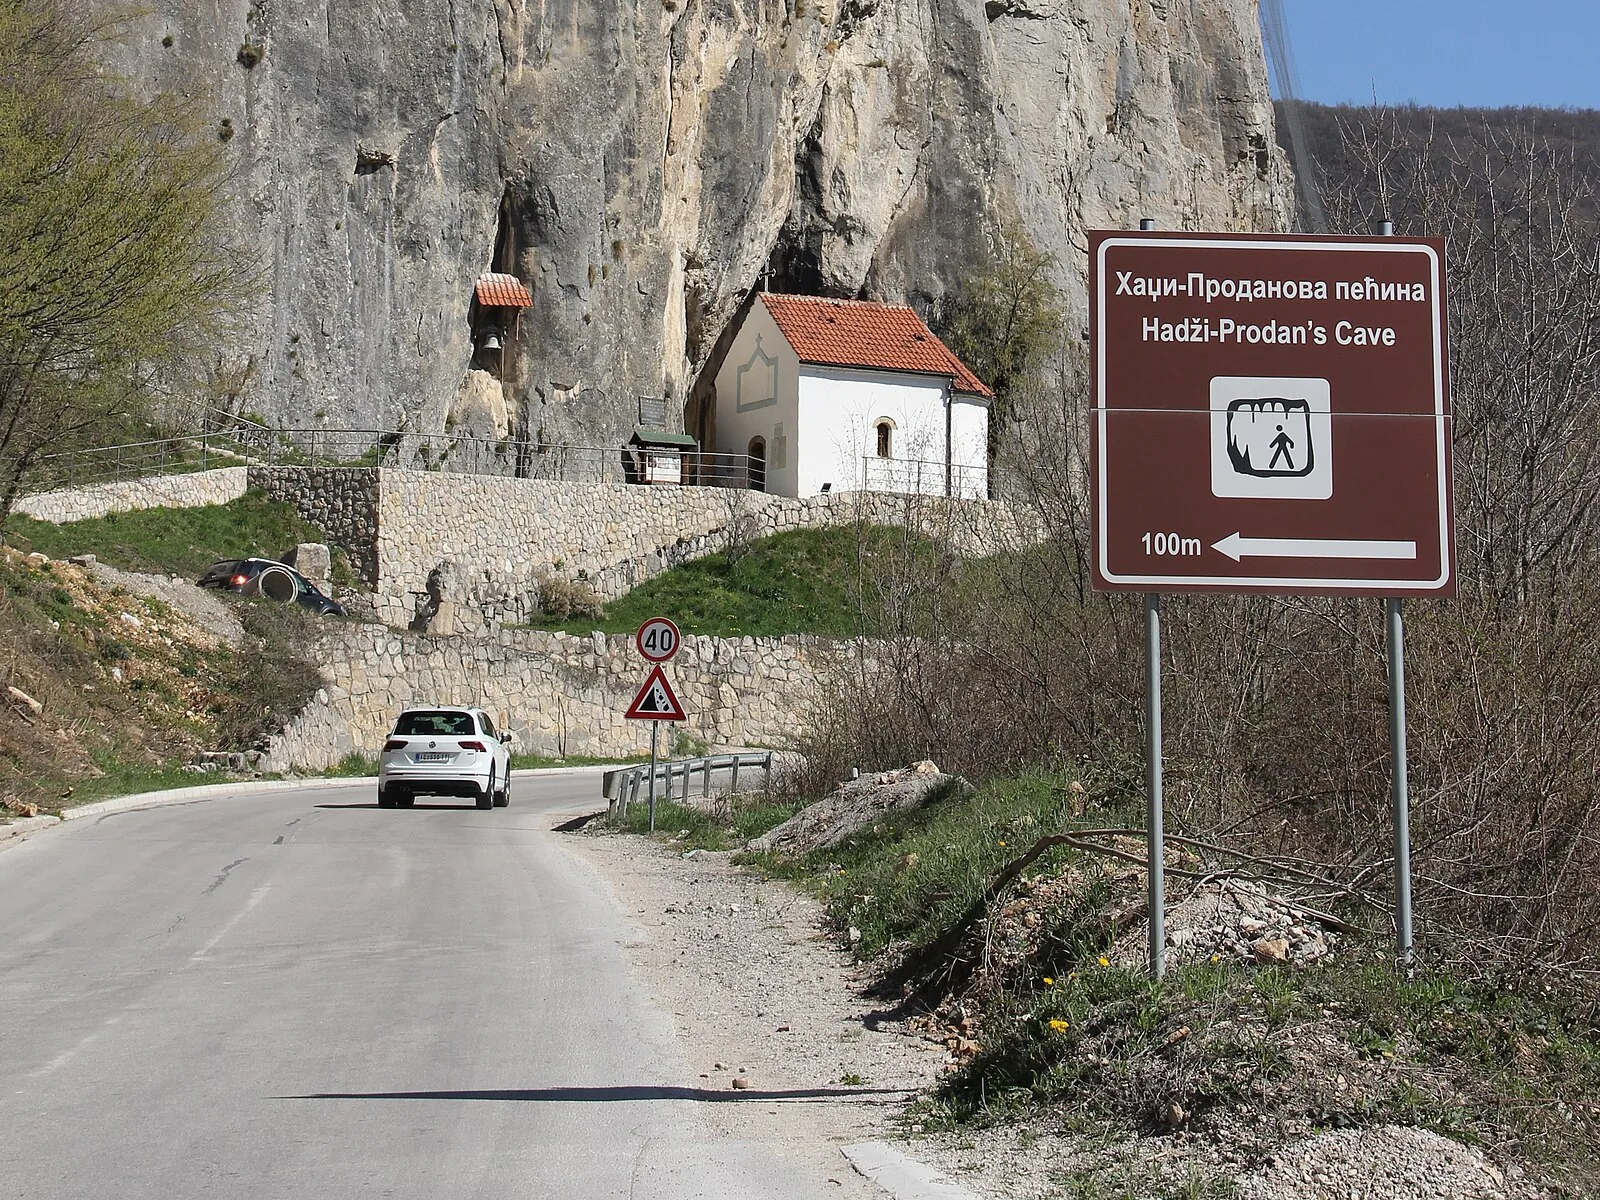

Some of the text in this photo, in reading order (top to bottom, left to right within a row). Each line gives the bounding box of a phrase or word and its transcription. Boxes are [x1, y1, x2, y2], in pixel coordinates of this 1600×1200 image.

[1115, 271, 1426, 302] Хаџи-Проданова пећина
[1335, 320, 1396, 346] Cave
[1141, 531, 1201, 556] 100m
[645, 628, 672, 652] 40
